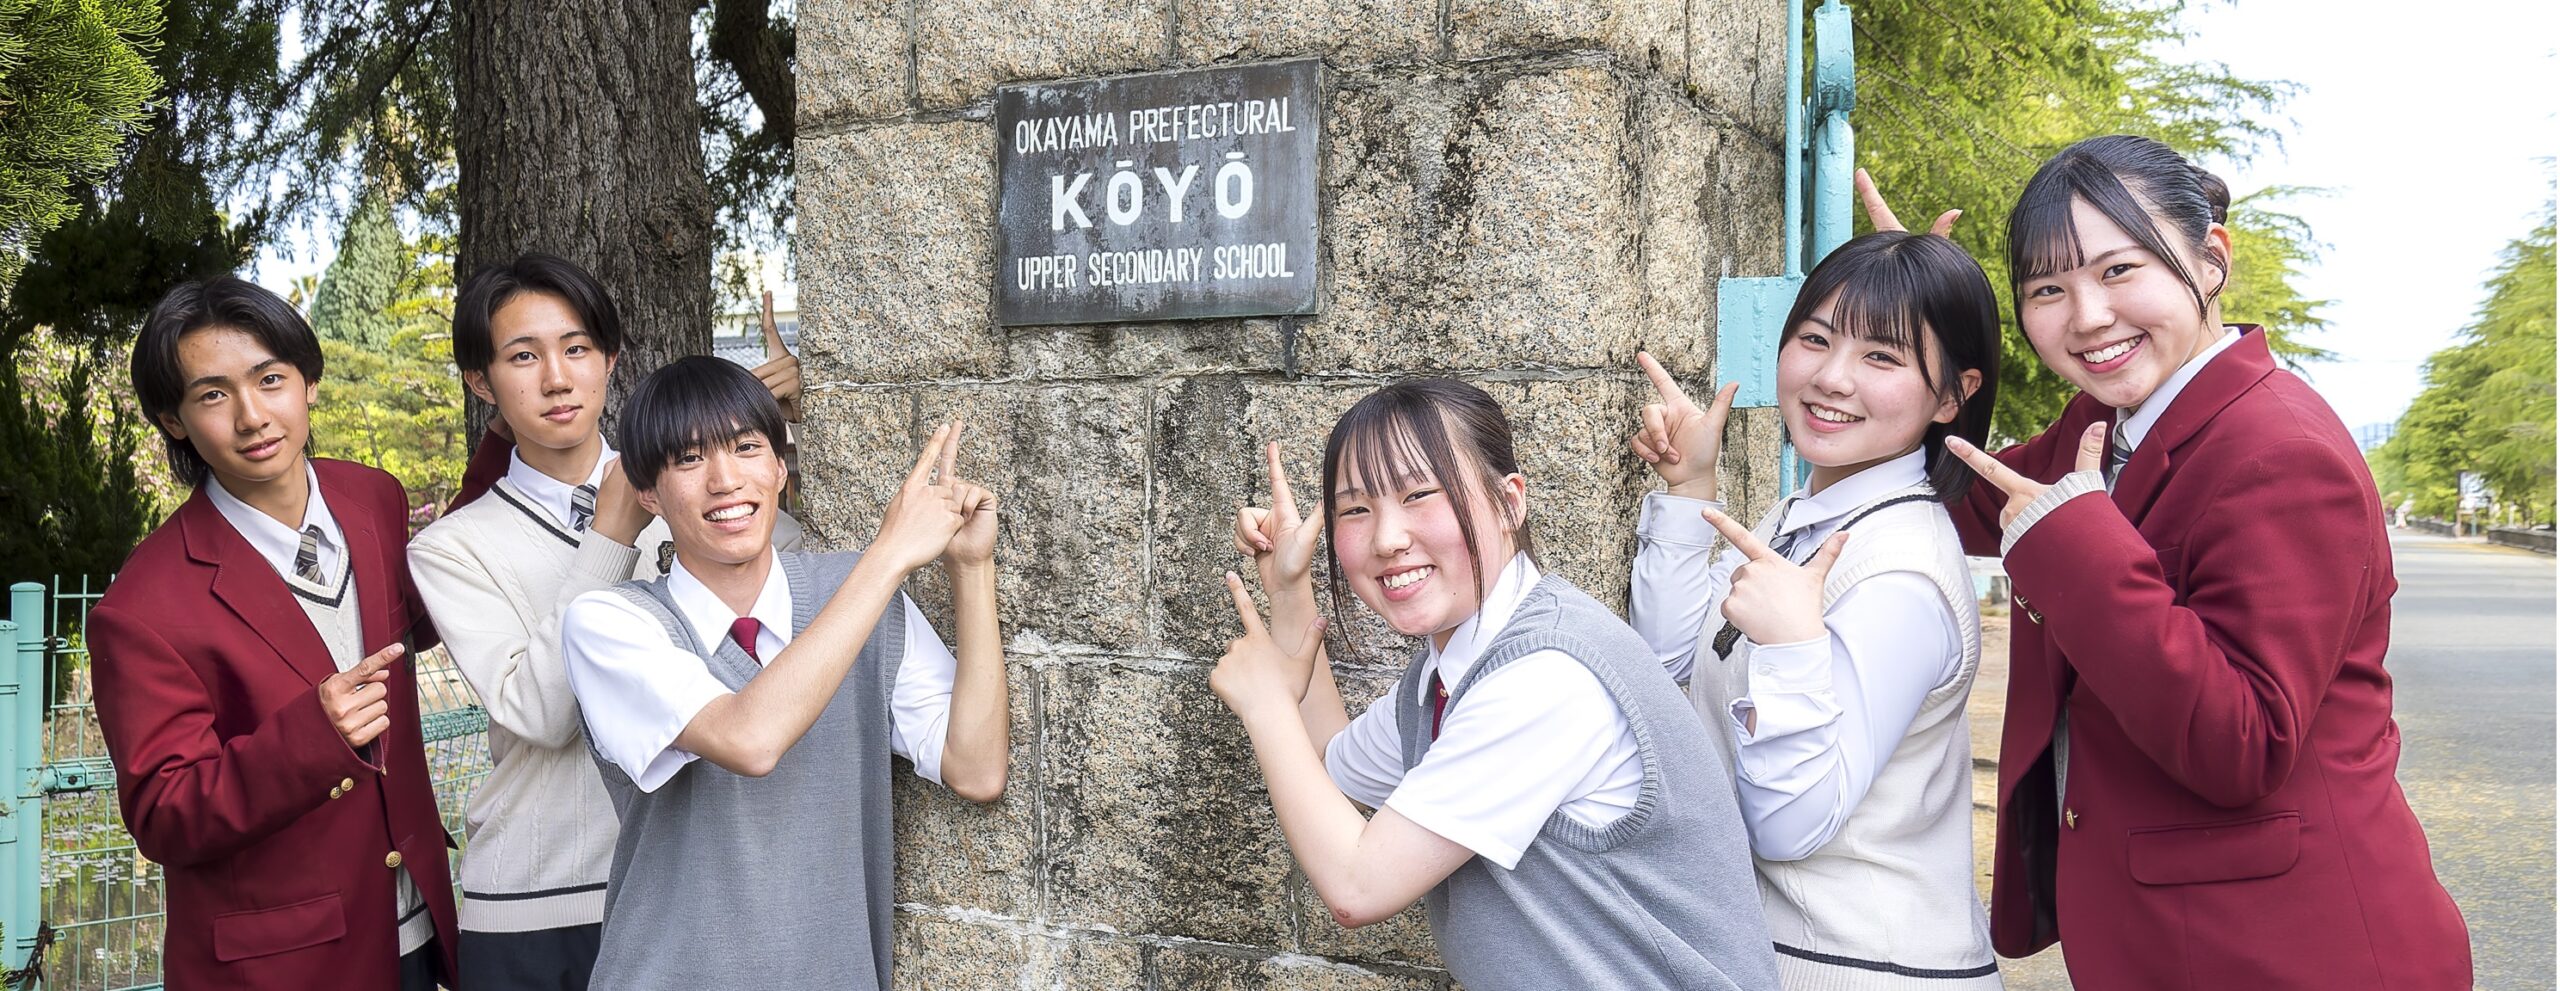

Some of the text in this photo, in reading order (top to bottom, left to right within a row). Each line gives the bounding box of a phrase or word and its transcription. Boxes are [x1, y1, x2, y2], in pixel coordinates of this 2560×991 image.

[1015, 96, 1296, 154] OKAYAMA PREFECTURAL
[1051, 152, 1254, 231] KŌYŌ
[1017, 242, 1294, 290] UPPER SECONDARY SCHOOL
